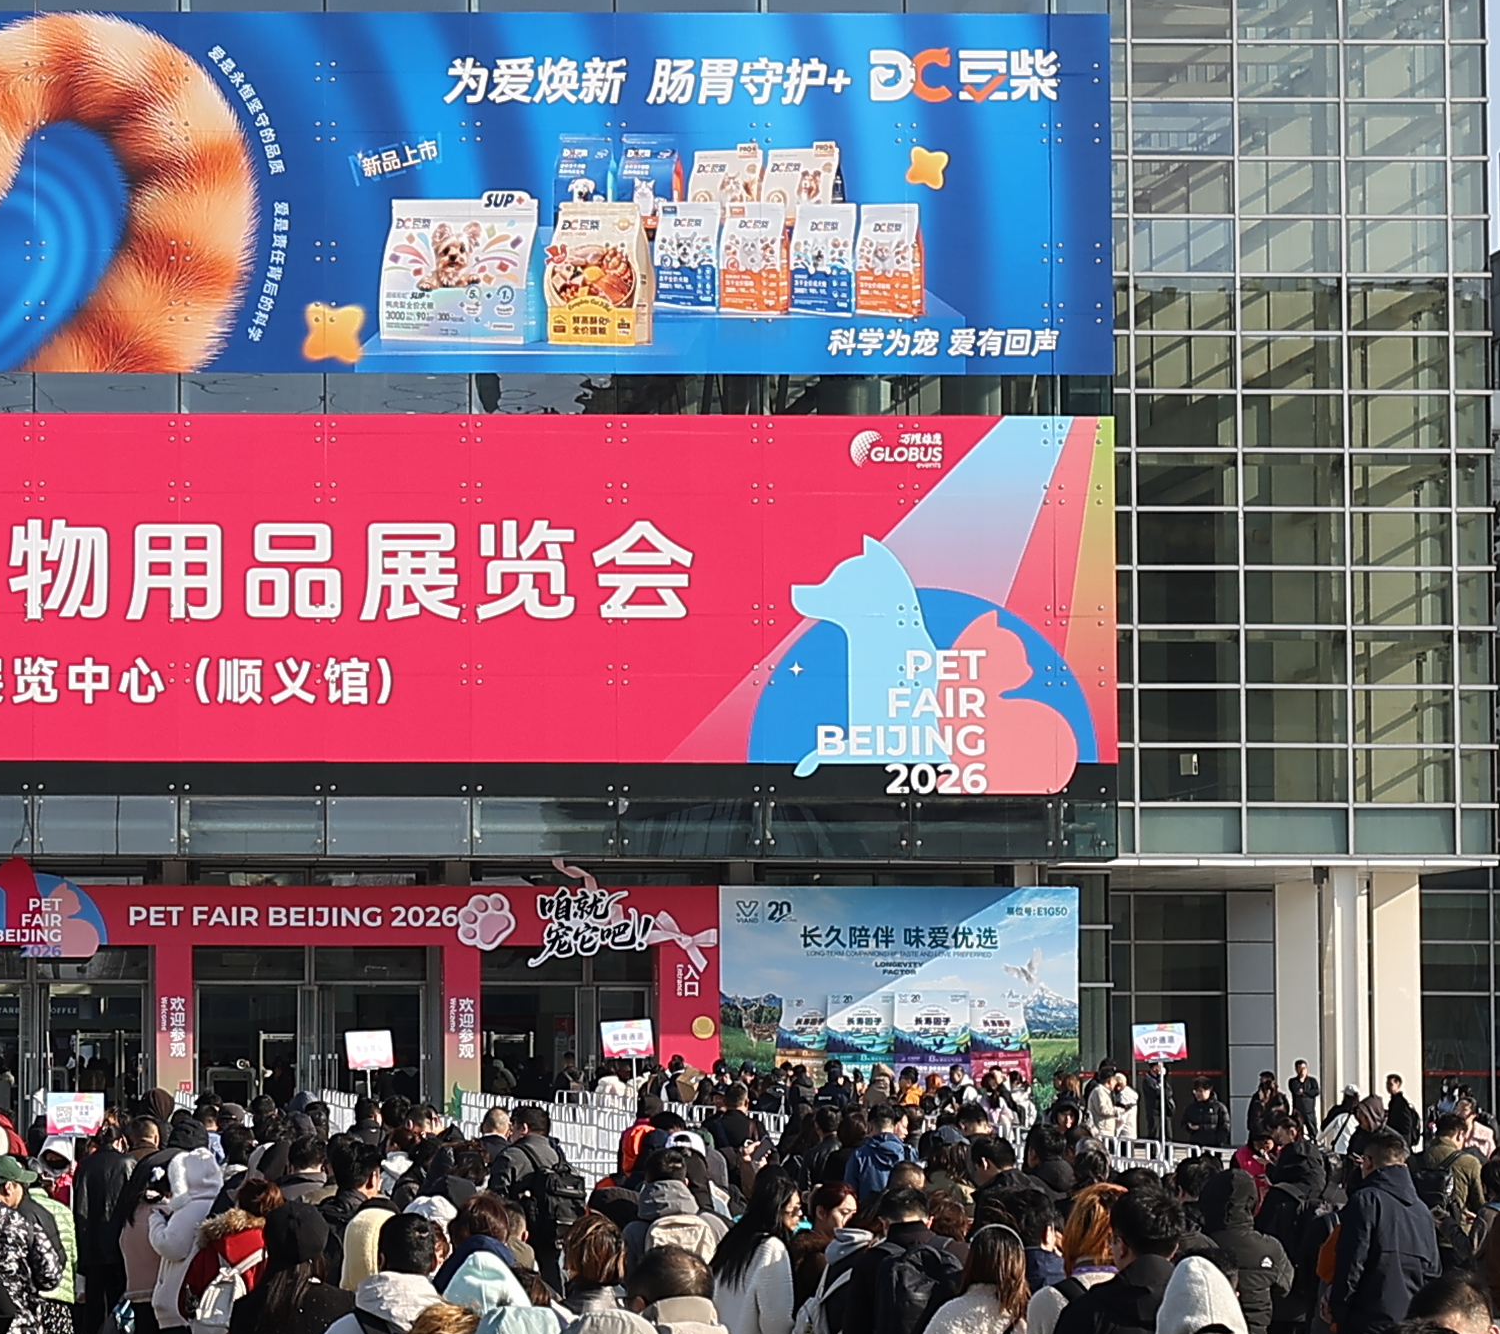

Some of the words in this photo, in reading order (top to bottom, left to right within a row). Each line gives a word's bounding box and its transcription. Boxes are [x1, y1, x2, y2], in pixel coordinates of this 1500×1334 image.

[443, 56, 628, 106] 为爱焕新
[647, 57, 851, 106] 肠胃守护+
[208, 44, 285, 175] 爱是永恒坚守的品质
[361, 139, 438, 177] 新品上市
[247, 201, 291, 342] 爱是责任背后的科学
[827, 328, 940, 357] 科学为宠
[947, 328, 1060, 357] 爱有回声
[870, 447, 942, 462] GLOBUS
[905, 649, 986, 681] PET
[887, 687, 986, 719] FAIR
[816, 725, 986, 758] BEIJING
[885, 762, 988, 796] 2026
[21, 913, 62, 927] FAIR
[29, 898, 62, 911] PET
[128, 906, 184, 927] PET
[192, 906, 259, 927] FAIR
[268, 906, 382, 927] BEIJING
[390, 906, 458, 927] 2026
[538, 888, 628, 921] 咱就
[20, 944, 62, 957] 2026
[800, 925, 895, 949] 长久陪伴
[903, 925, 999, 949] 味爱优选
[684, 964, 700, 997] 入口
[170, 997, 186, 1057] 欢迎参观
[459, 998, 474, 1058] 欢迎参观
